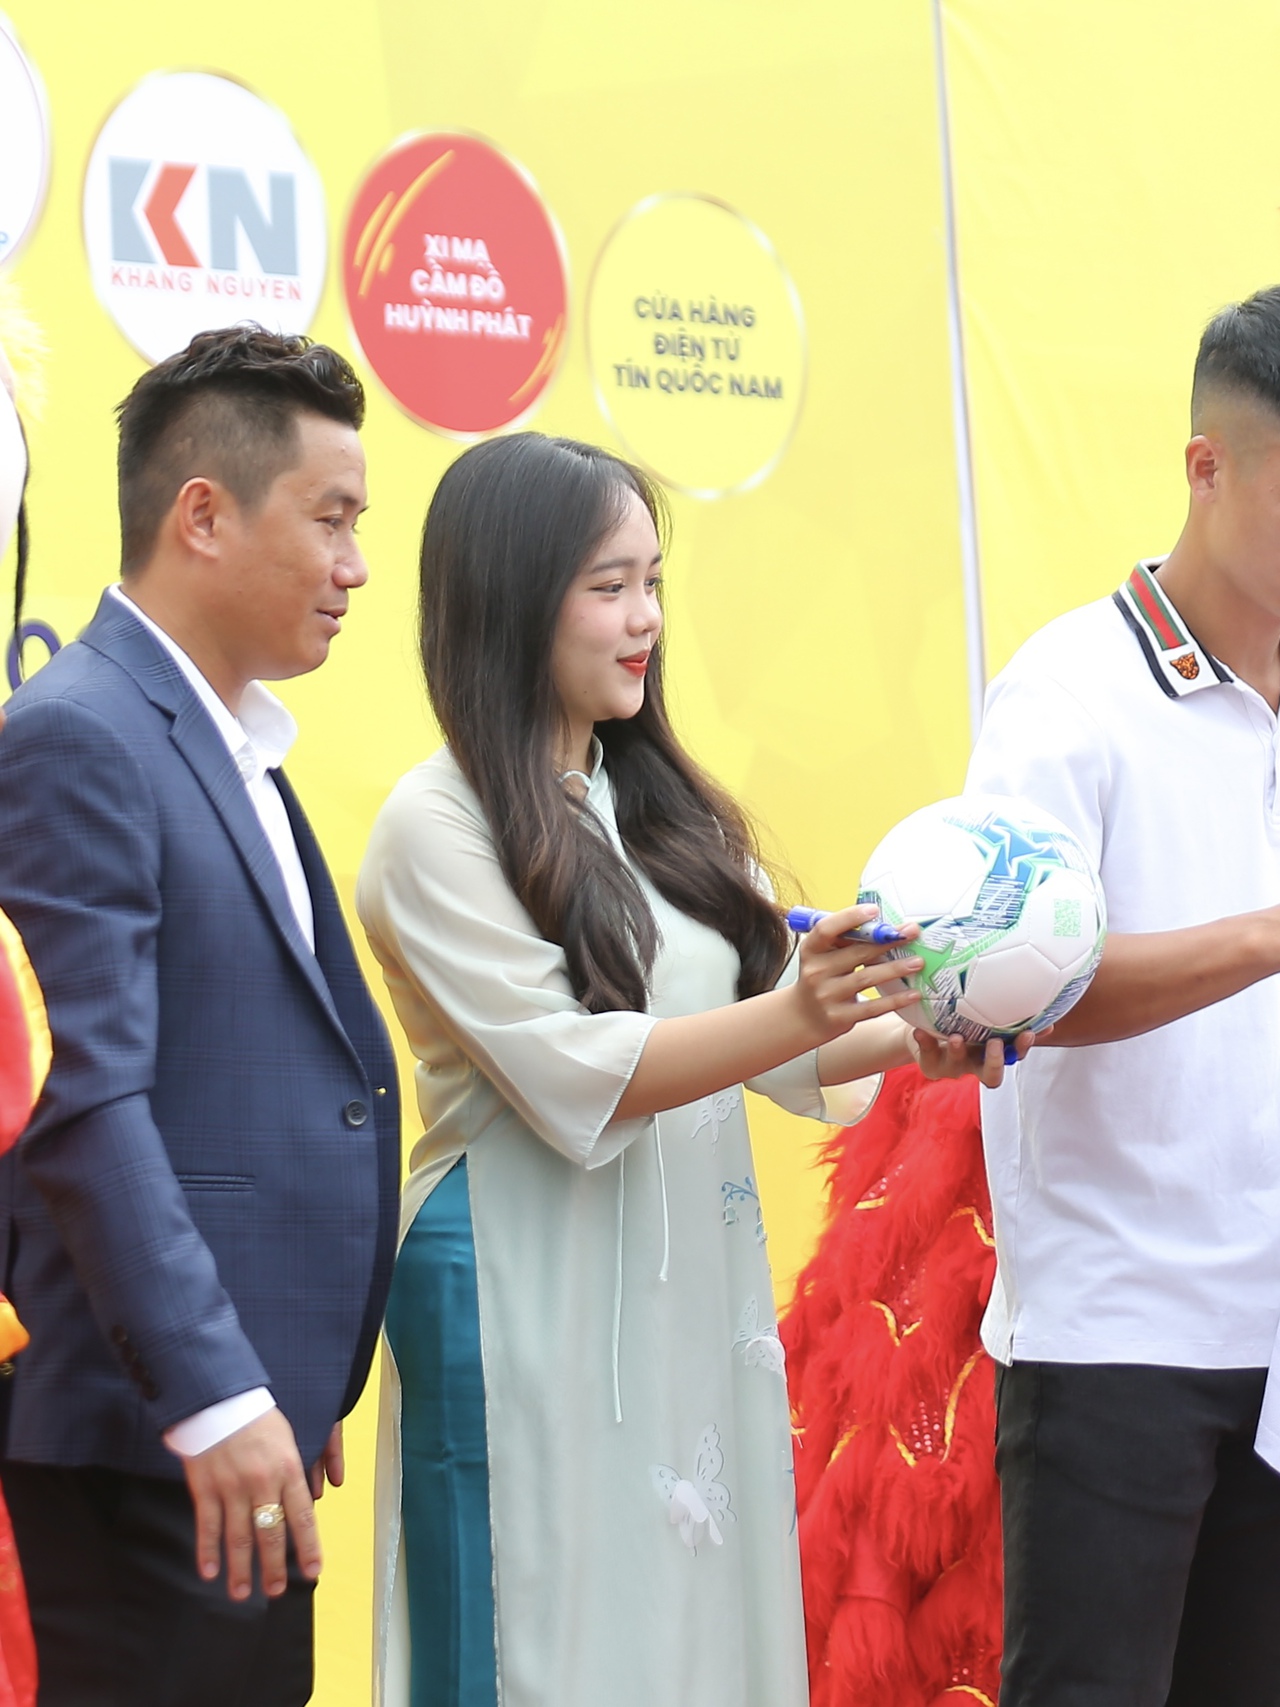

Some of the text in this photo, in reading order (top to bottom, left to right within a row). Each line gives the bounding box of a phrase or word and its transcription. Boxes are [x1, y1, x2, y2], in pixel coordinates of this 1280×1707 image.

[108, 155, 299, 275] KN
[424, 234, 449, 259] XI
[111, 266, 302, 301] KHANG NGUYEN
[410, 257, 468, 297] CẦM
[384, 298, 532, 340] HUỲNH PHÁT
[634, 289, 757, 328] CỬA HÀNG
[653, 327, 705, 362] ĐIỆN
[656, 362, 723, 394] QUỐC
[729, 373, 783, 399] NAM
